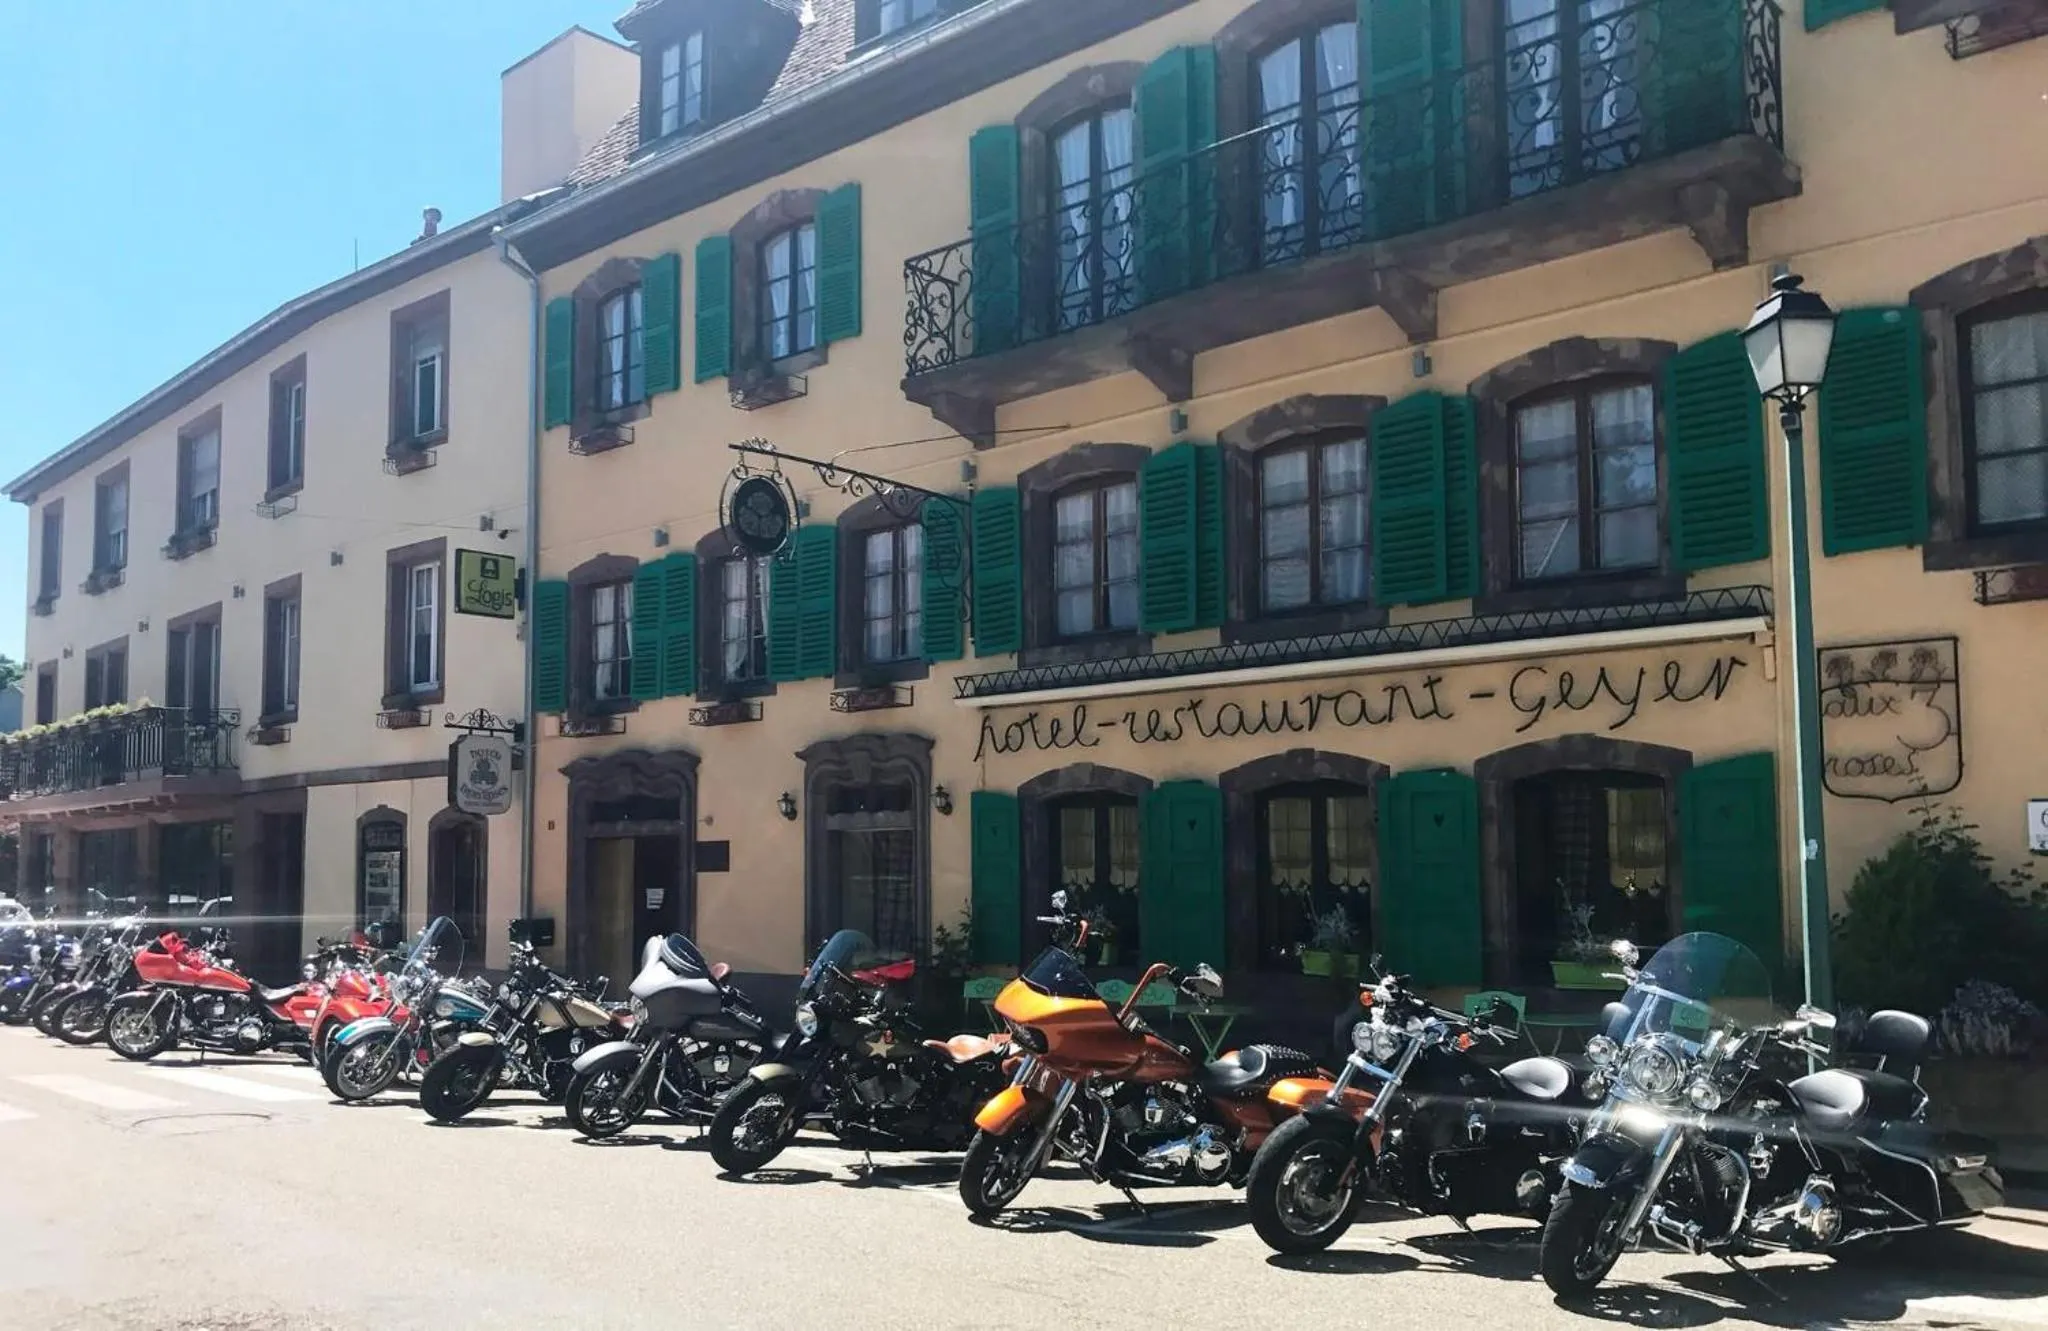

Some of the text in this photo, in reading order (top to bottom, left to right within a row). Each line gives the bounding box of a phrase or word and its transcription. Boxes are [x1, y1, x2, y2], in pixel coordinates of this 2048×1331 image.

[465, 579, 513, 611] Logis
[1509, 656, 1748, 733] Geyer
[1823, 686, 1952, 751] aux 3
[1825, 749, 1918, 778] roses
